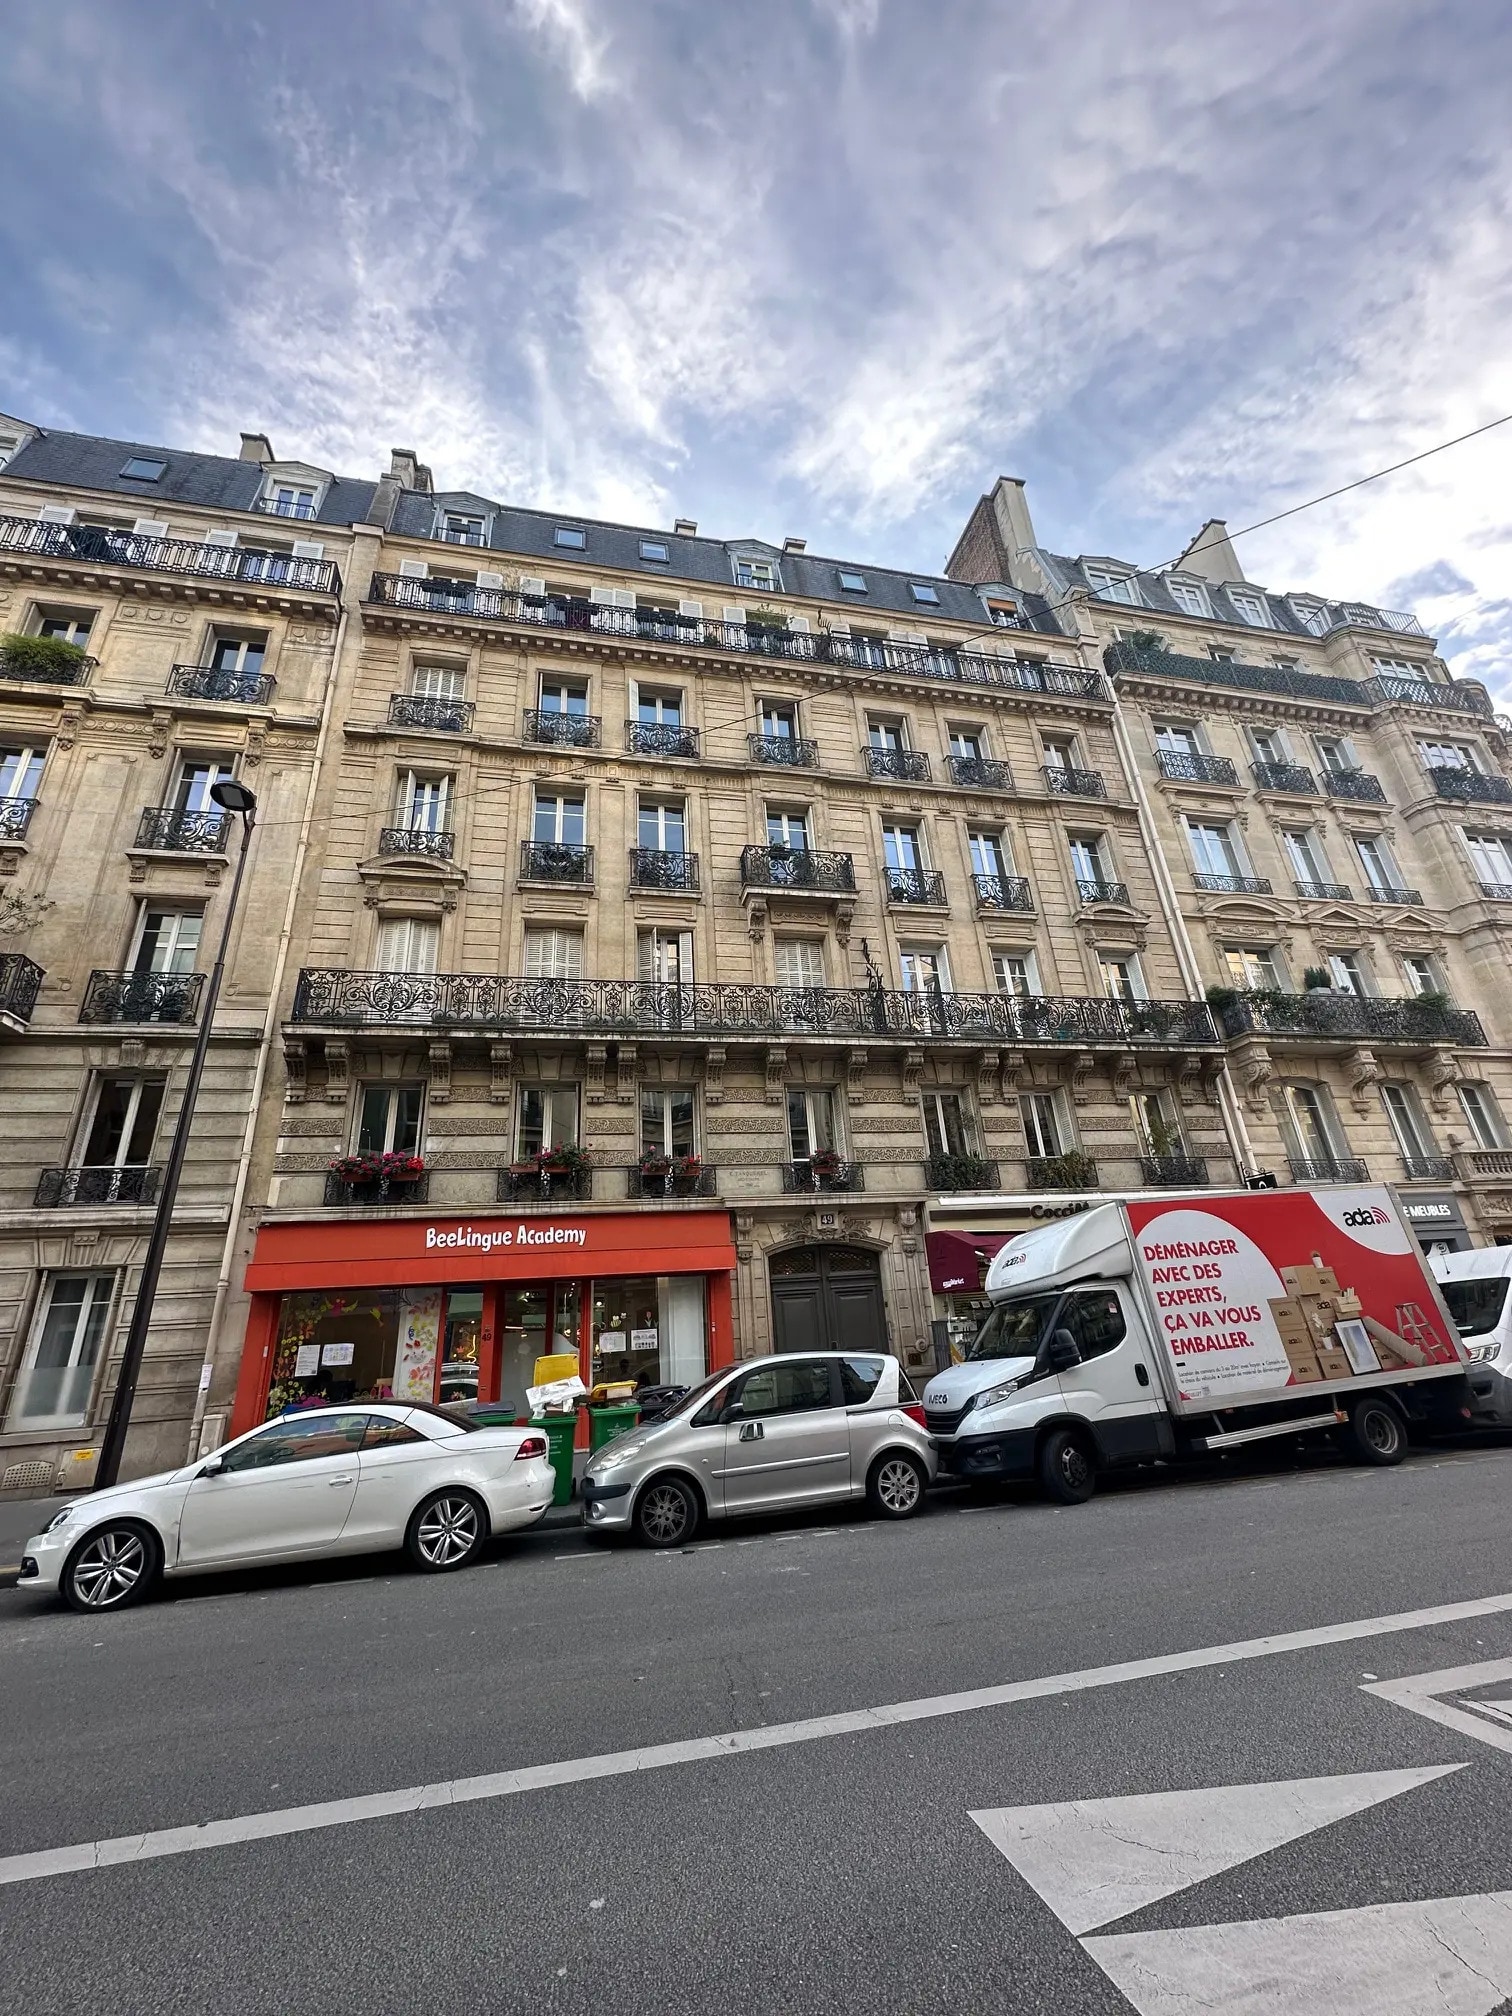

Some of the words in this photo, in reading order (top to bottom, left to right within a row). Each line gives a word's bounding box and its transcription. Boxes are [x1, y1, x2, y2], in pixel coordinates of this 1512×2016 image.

[822, 1215, 833, 1224] 49
[1343, 1207, 1376, 1227] ada
[1409, 1204, 1451, 1217] MEUBLES
[426, 1226, 512, 1252] BeeLingue
[517, 1225, 586, 1246] Academy
[1143, 1239, 1239, 1262] DÉMÉNAGER
[1152, 1265, 1191, 1284] AVEC
[1192, 1263, 1222, 1280] DES
[1156, 1286, 1227, 1308] EXPERTS,
[1164, 1313, 1189, 1333] ÇA
[1188, 1310, 1215, 1328] VA
[1213, 1305, 1262, 1325] VOUS
[1170, 1331, 1255, 1356] EMBALLER.
[928, 1394, 949, 1405] IVECO
